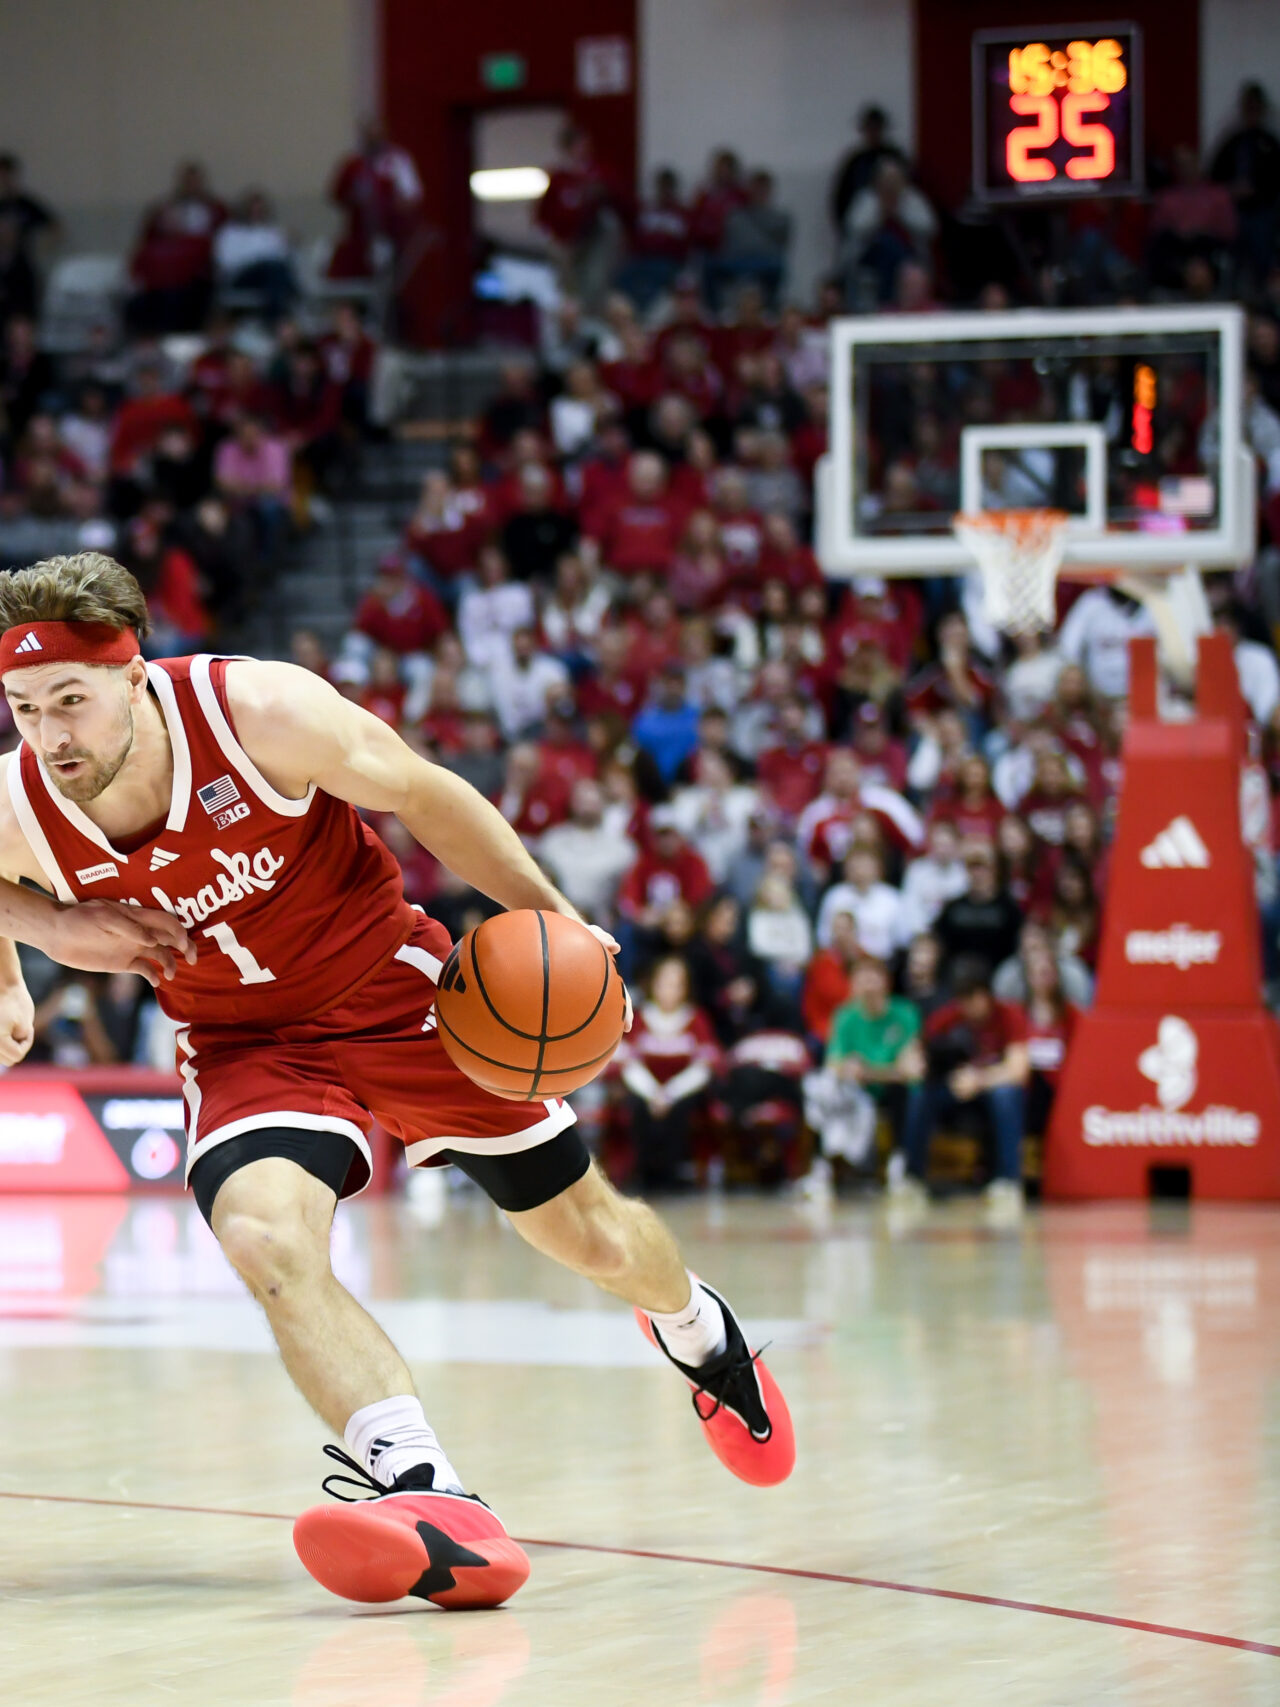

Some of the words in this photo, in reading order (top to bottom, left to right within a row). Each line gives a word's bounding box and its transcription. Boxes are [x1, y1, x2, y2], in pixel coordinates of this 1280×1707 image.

[1008, 39, 1127, 97] 15:36
[1006, 92, 1116, 182] 25
[202, 921, 277, 985] 1
[1125, 923, 1221, 970] meijer
[1082, 1103, 1260, 1147] Smithville
